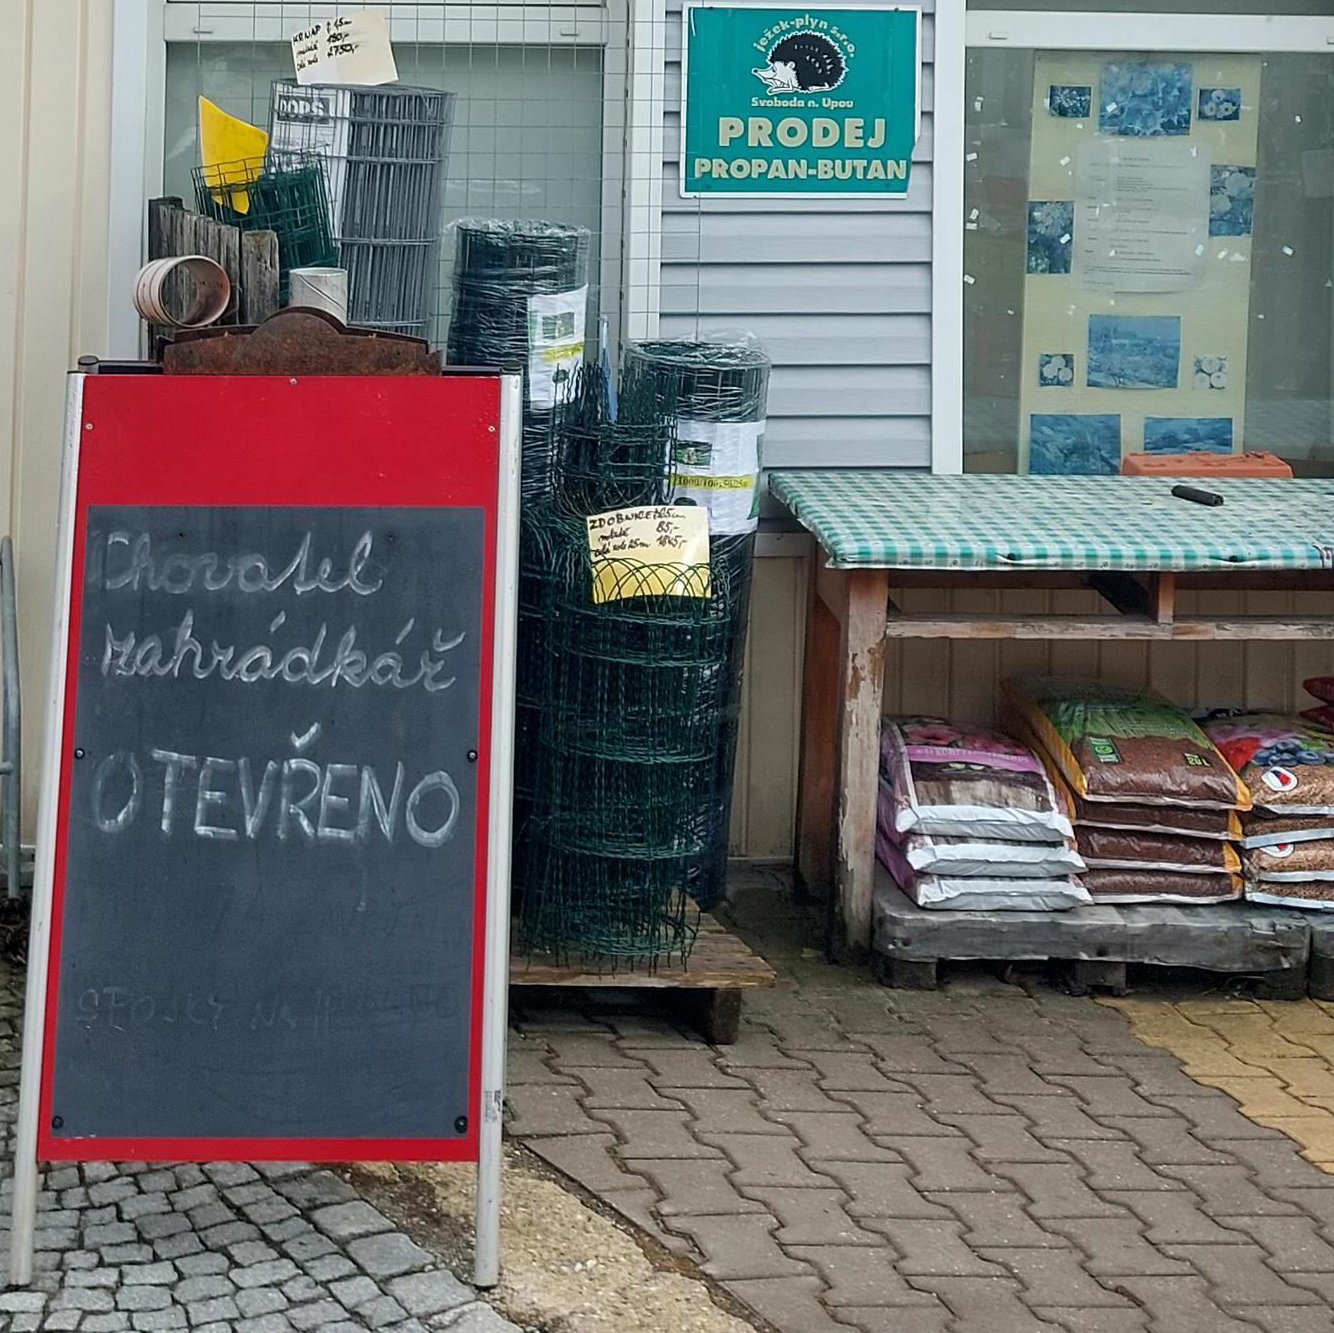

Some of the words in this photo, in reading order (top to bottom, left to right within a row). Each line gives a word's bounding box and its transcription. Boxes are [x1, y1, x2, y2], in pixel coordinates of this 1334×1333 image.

[753, 13, 829, 53] ježek-plyn
[829, 26, 856, 58] s.r.o.
[750, 96, 805, 108] Svoboda
[807, 99, 819, 108] n.
[718, 116, 886, 149] PRODEJ
[694, 157, 908, 181] PROPAN-BUTAN
[104, 528, 384, 598] Chovatel
[101, 608, 467, 694] zahrádkář
[92, 722, 461, 849] OTEVŘENO
